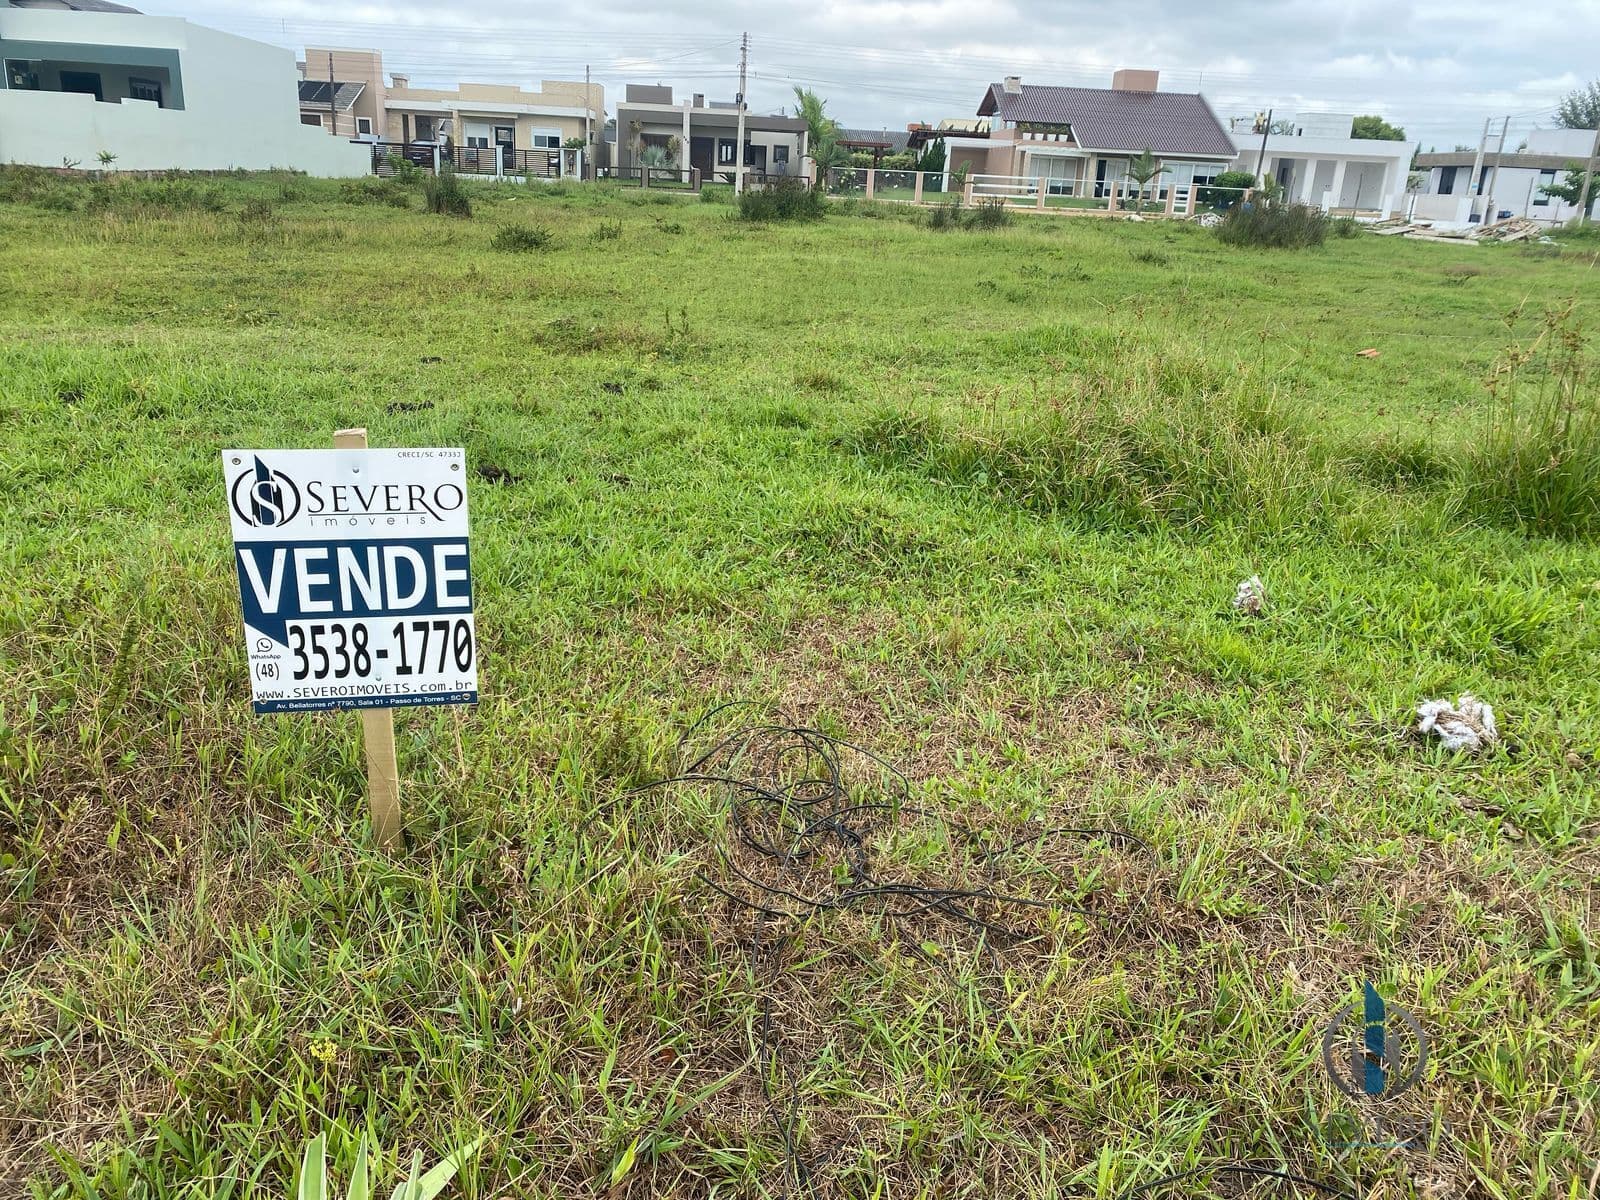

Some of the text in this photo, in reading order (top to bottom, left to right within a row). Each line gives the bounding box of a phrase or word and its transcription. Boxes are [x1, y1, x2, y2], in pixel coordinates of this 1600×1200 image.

[397, 451, 461, 459] CRECI/SC 4733J
[306, 481, 464, 522] SEVERO
[310, 514, 427, 527] imóveis
[238, 544, 470, 614] VENDE
[289, 618, 473, 681] 3538-1770
[255, 662, 280, 681] (48)
[256, 680, 473, 699] www.SEVEROIMOVEIS.com.br
